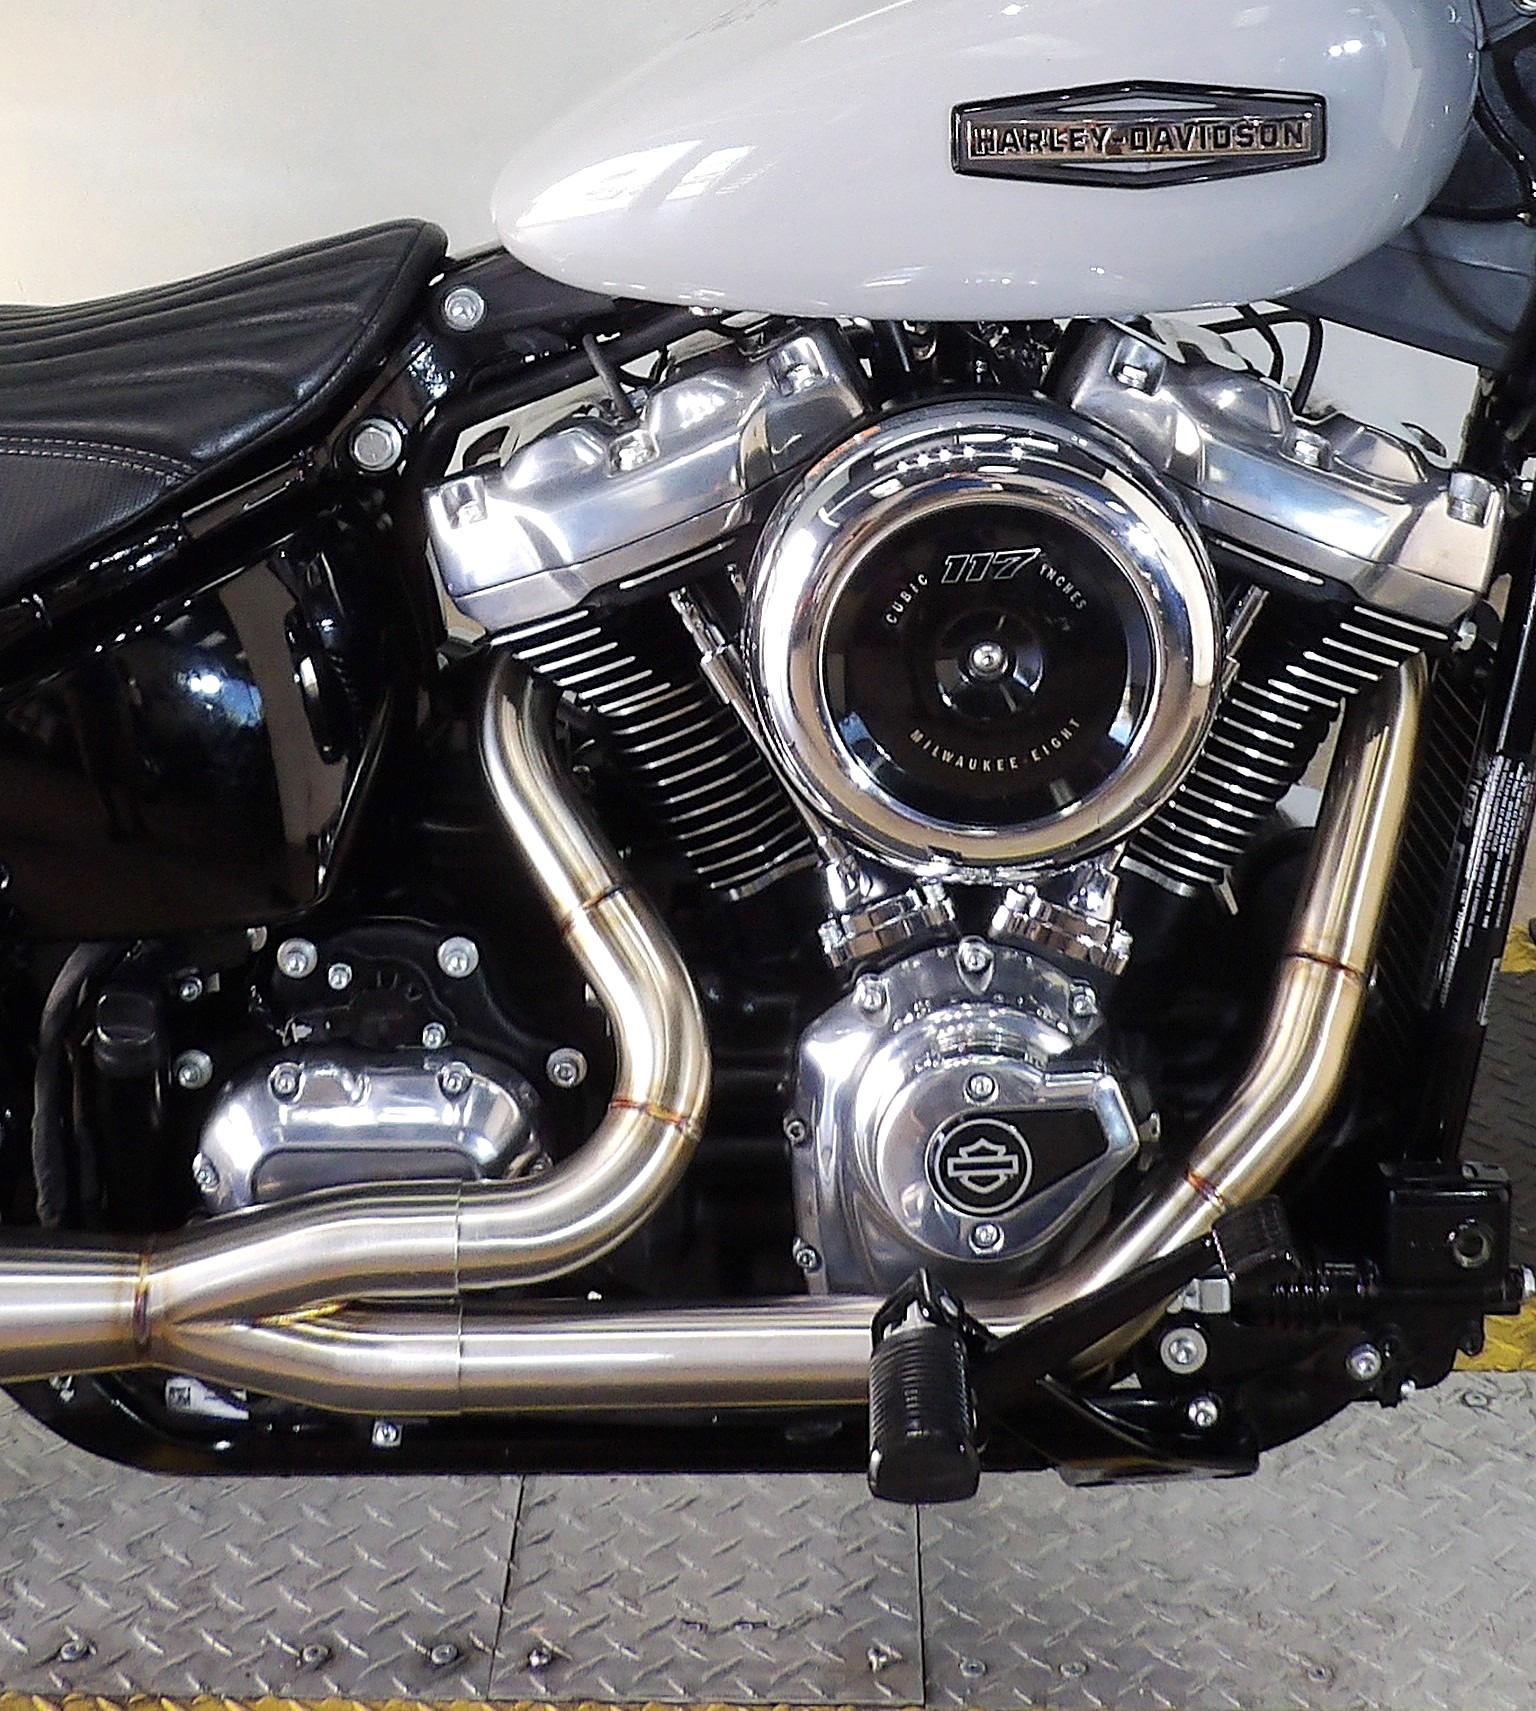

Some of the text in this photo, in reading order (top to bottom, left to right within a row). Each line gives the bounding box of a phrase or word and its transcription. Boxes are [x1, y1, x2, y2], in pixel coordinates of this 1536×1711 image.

[972, 121, 1303, 156] HARLEY-DAVIDSON
[885, 547, 1088, 625] CUBIC 117 INCHES
[910, 728, 1019, 773] MILWAUKEE
